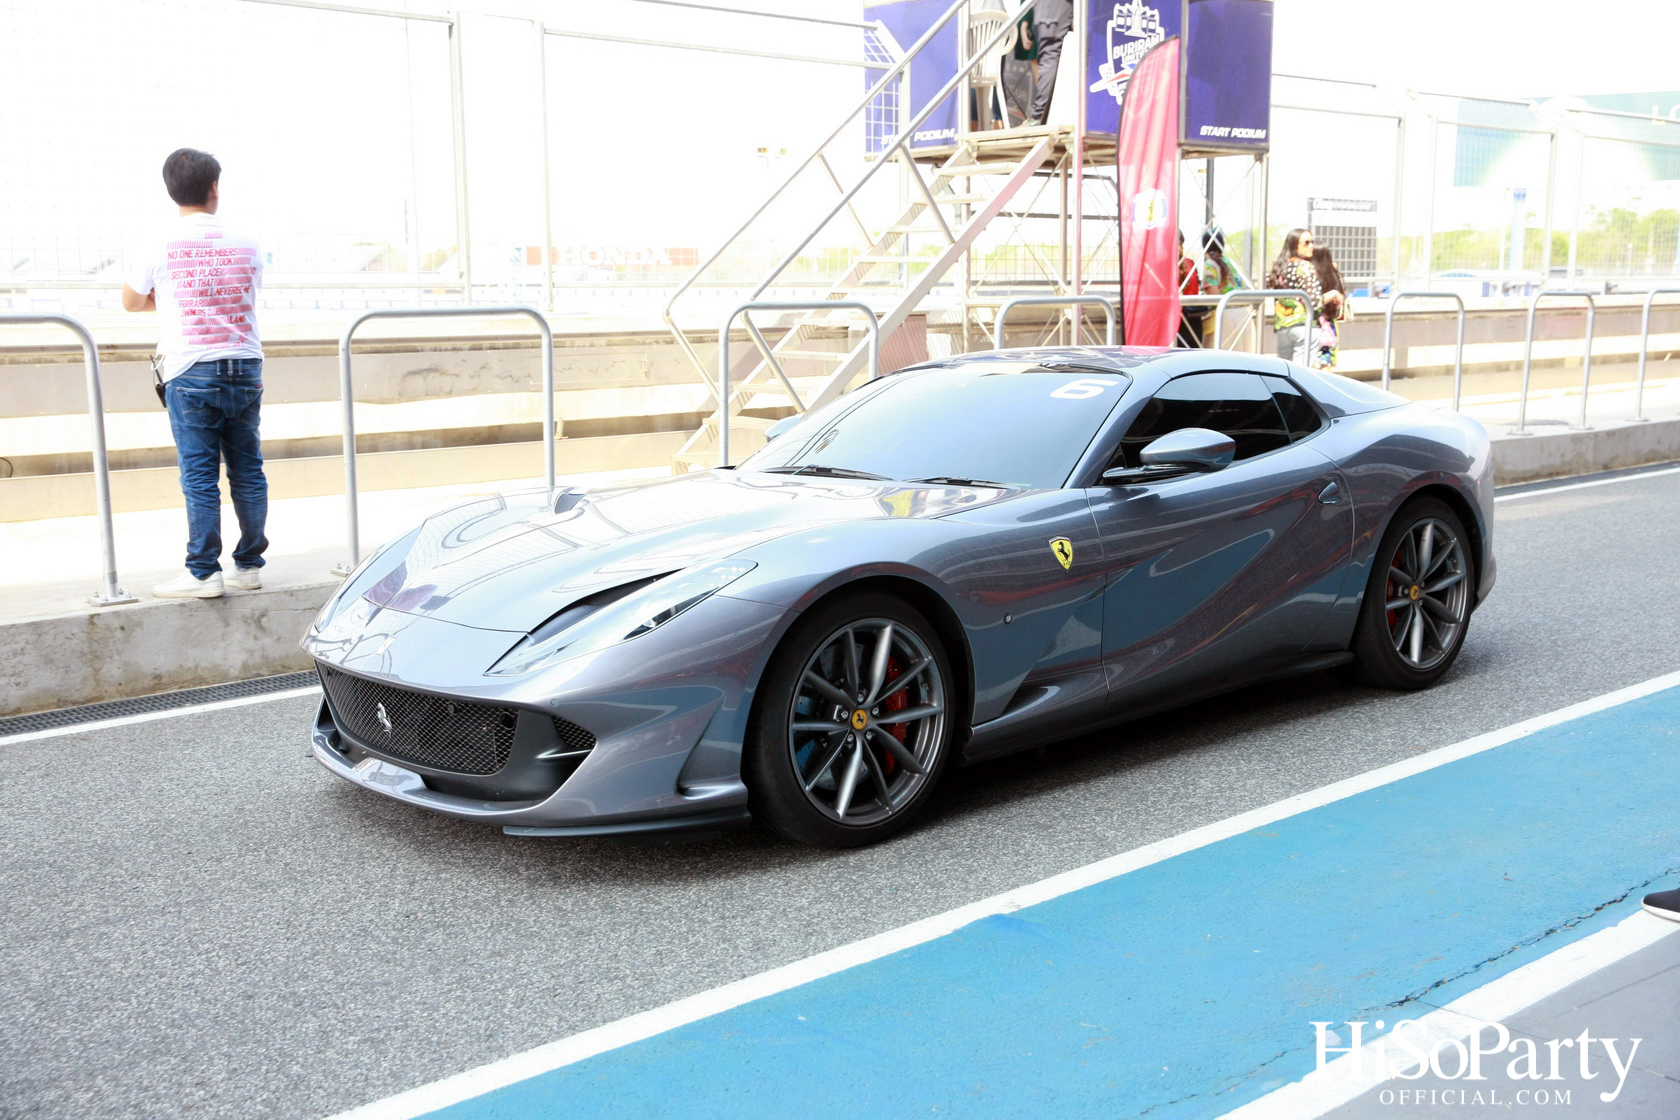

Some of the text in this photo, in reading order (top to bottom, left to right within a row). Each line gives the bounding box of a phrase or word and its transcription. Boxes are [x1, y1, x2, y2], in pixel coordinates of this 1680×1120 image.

[1113, 35, 1160, 60] BURIRAM
[914, 128, 955, 141] PODIUM
[1200, 125, 1266, 139] START PODIUM
[168, 247, 238, 260] NO ONE REMEMBERS
[557, 246, 673, 266] HONDA
[198, 258, 214, 267] WHO
[171, 268, 221, 280] SECOND PLACE
[1049, 378, 1120, 399] 6
